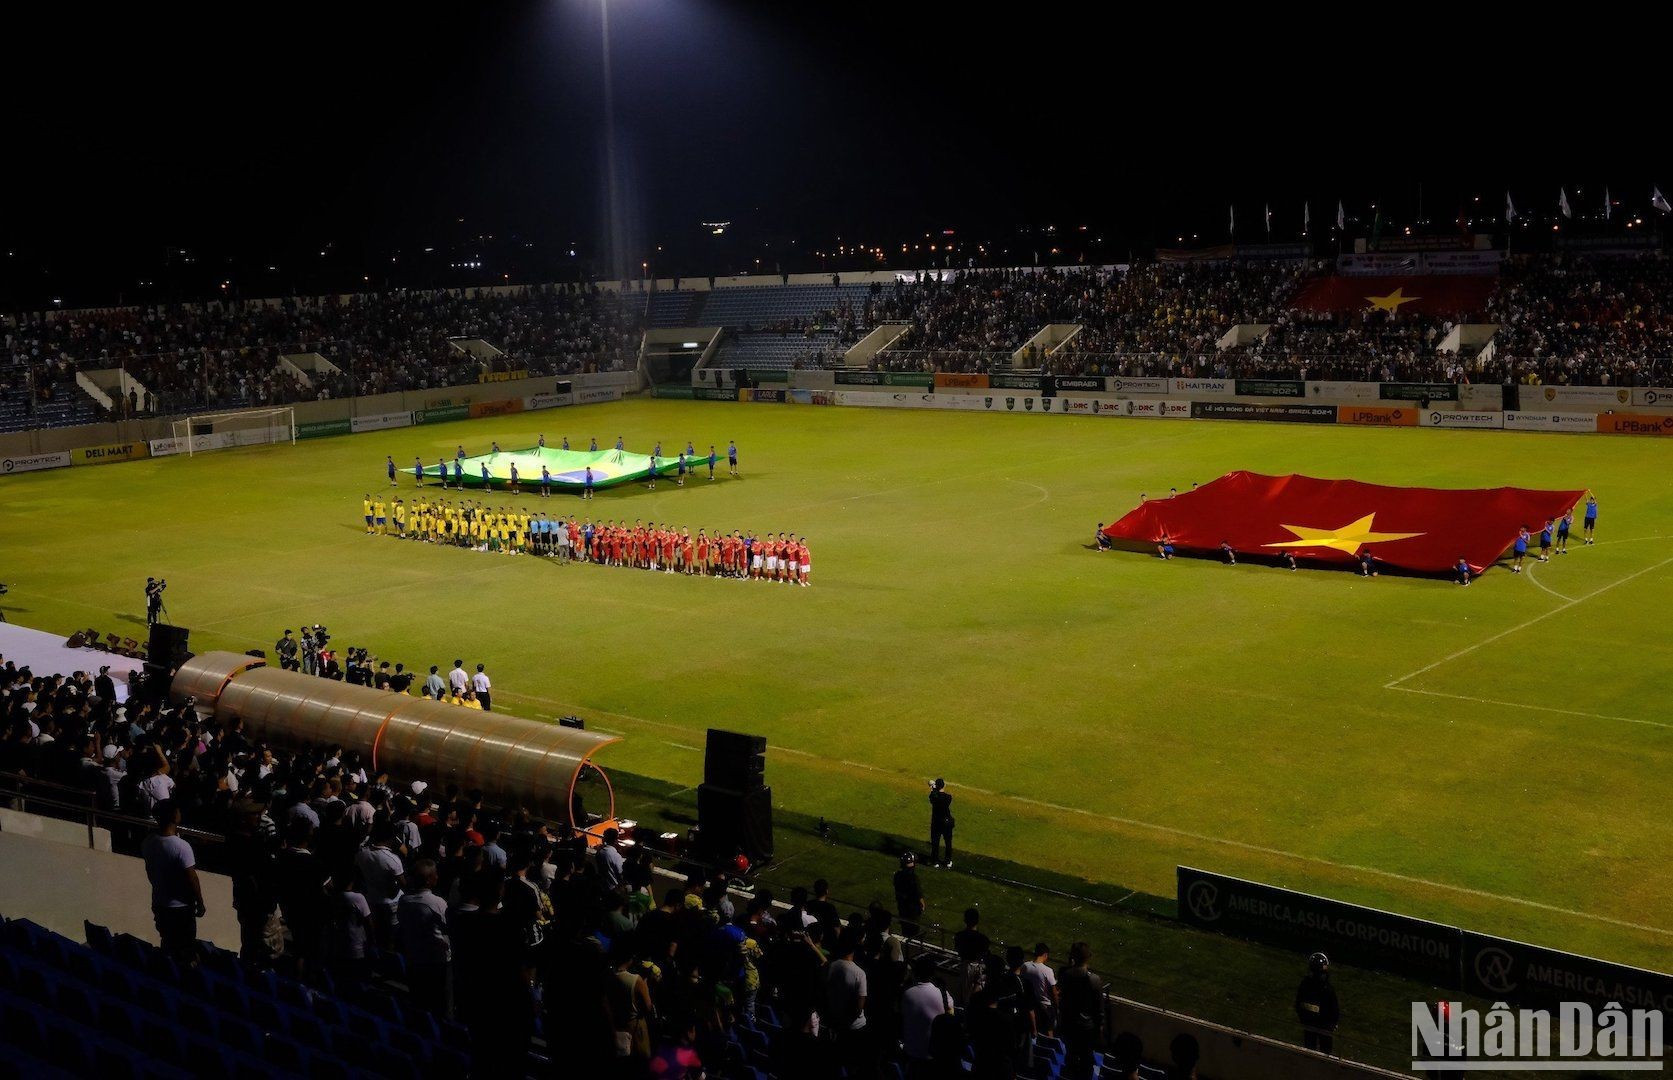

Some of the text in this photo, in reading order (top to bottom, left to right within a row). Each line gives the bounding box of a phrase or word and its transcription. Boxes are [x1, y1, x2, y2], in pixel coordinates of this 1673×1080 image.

[1062, 380, 1098, 388] EMBRAER
[1272, 387, 1298, 395] 2024
[1353, 412, 1392, 423] LPBank
[1614, 421, 1662, 433] LPBank
[86, 445, 133, 458] DELI MART
[15, 456, 61, 466] PROWTECH
